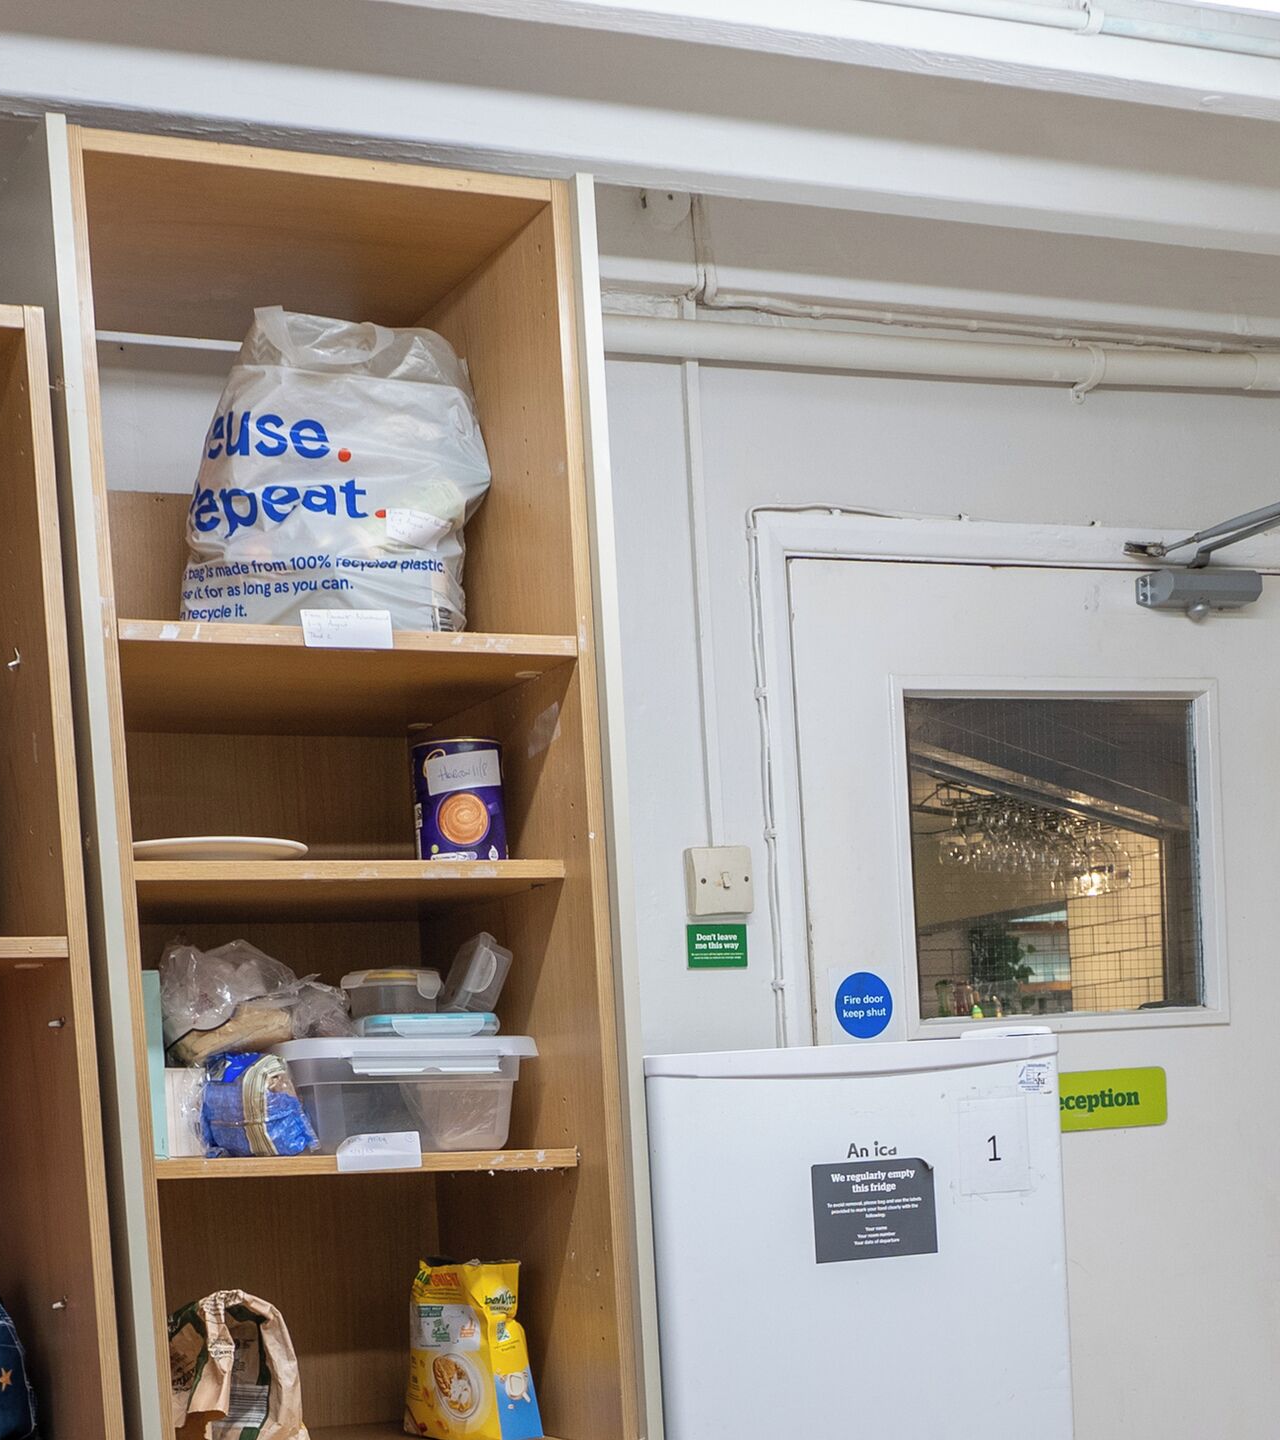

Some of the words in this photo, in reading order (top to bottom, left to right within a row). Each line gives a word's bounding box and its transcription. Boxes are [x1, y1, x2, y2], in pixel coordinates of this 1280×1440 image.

[207, 411, 352, 462] euse.
[190, 478, 386, 539] epeat.
[189, 568, 204, 582] bag
[216, 562, 249, 578] made
[252, 559, 287, 573] from
[290, 555, 332, 571] 100%
[336, 557, 397, 572] recycled
[194, 587, 202, 599] it
[204, 585, 223, 598] for
[228, 585, 240, 597] as
[244, 579, 271, 598] long
[274, 580, 289, 594] as
[292, 580, 317, 595] you
[321, 578, 353, 590] can.
[188, 606, 231, 622] recycle
[235, 604, 248, 617] it.
[717, 933, 737, 941] leave
[844, 995, 861, 1004] Fire
[863, 994, 884, 1003] door
[843, 1009, 865, 1019] keep
[866, 1008, 886, 1017] shut
[1060, 1088, 1140, 1112] eception
[987, 1135, 1002, 1161] 1
[831, 1173, 845, 1182] We
[846, 1171, 886, 1182] regularly
[888, 1169, 915, 1179] empty
[852, 1184, 869, 1192] this
[870, 1182, 896, 1192] fridge
